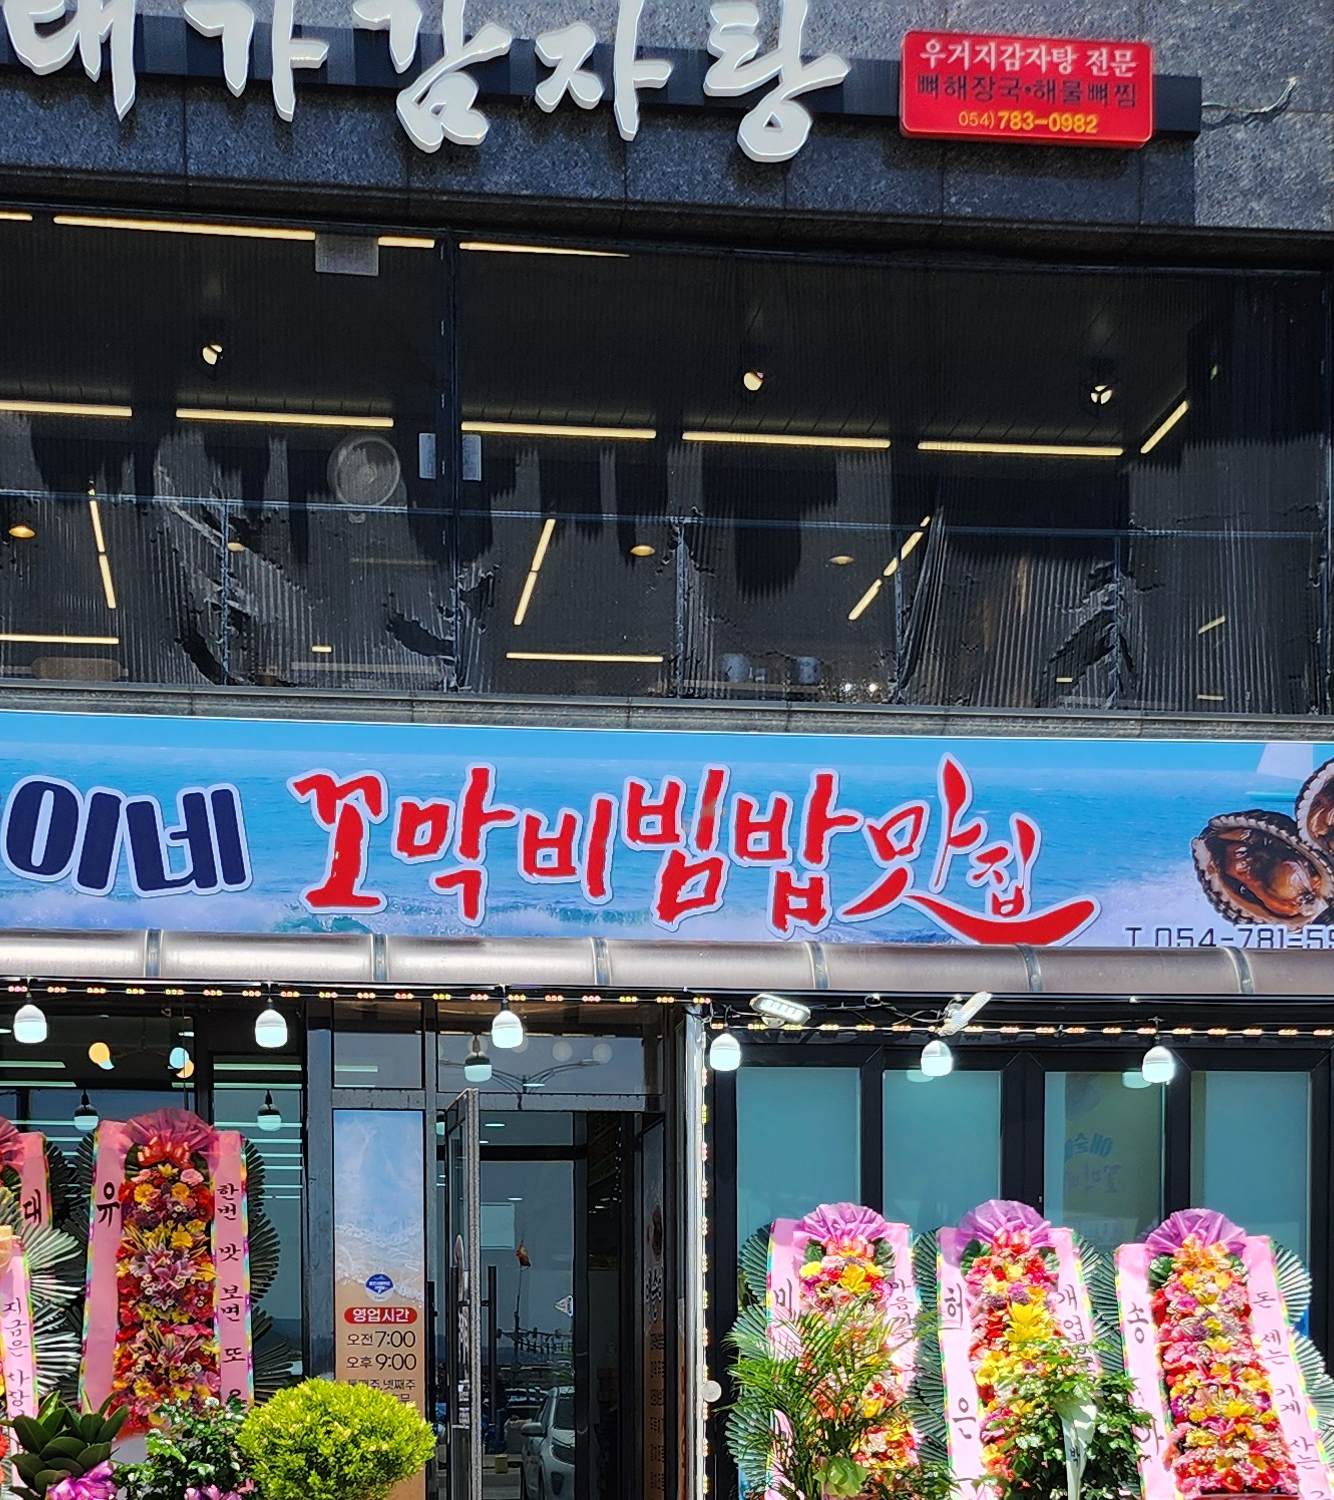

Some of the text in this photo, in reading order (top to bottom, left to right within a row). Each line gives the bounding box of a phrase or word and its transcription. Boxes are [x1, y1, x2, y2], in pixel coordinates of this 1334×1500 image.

[919, 39, 1138, 78] 우거지감자탕 전문
[217, 1183, 240, 1221] 한번
[352, 1308, 410, 1323] 영업시간
[347, 1331, 416, 1349] 오전 7:00
[347, 1354, 417, 1371] 오후 9:00
[7, 1369, 30, 1416] 사장
[1275, 1384, 1301, 1416] 기계
[1291, 1436, 1319, 1469] 사는
